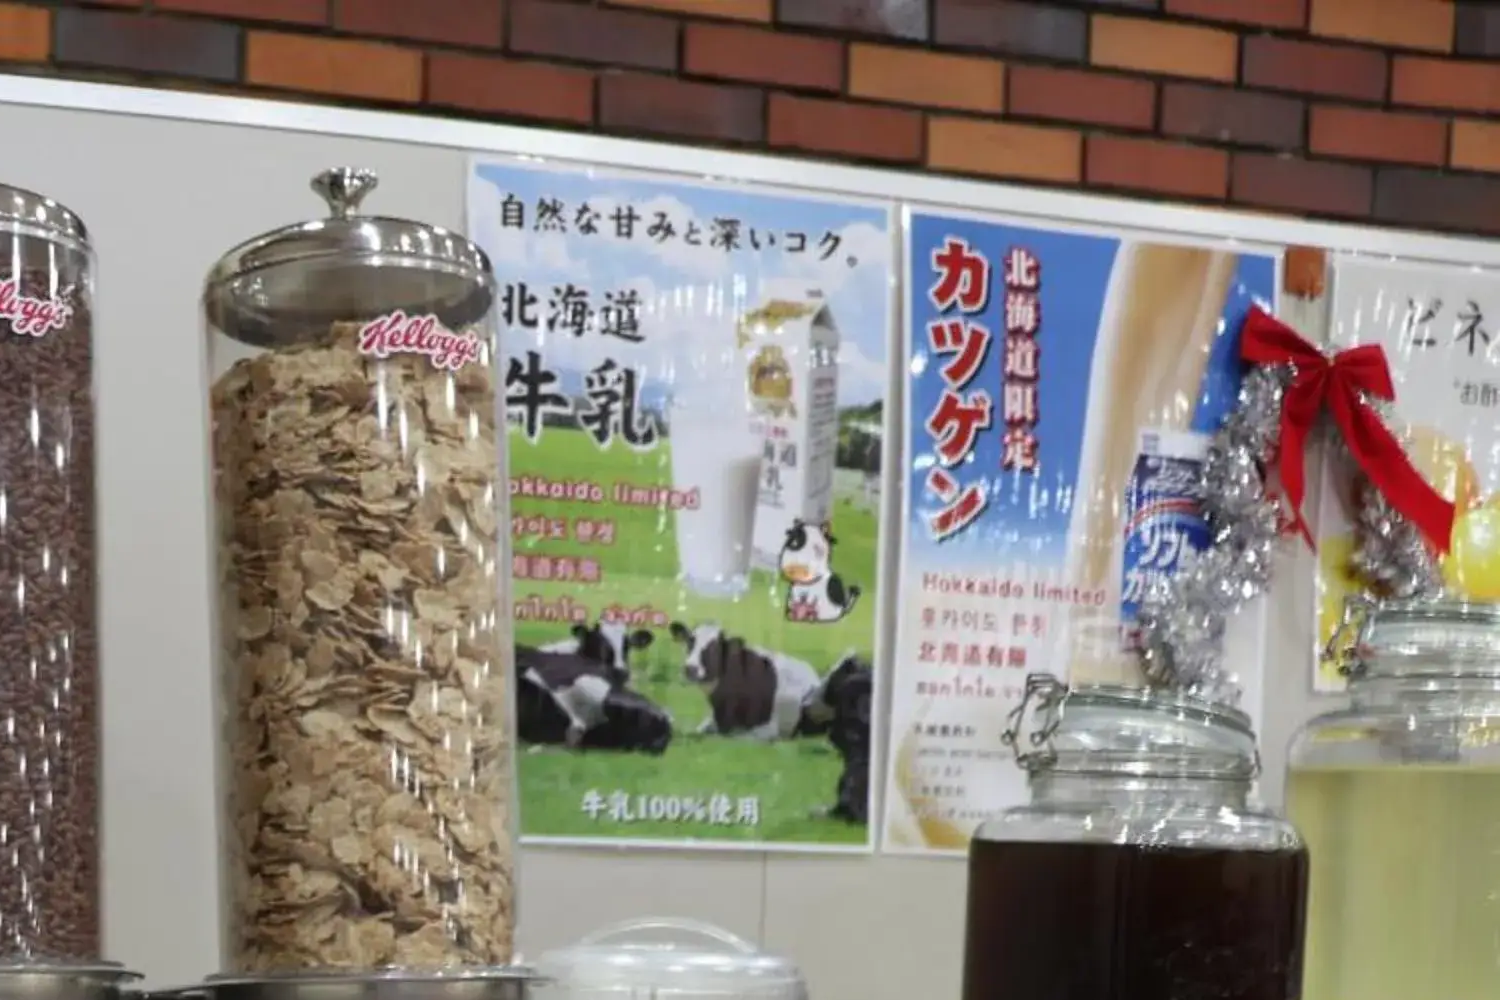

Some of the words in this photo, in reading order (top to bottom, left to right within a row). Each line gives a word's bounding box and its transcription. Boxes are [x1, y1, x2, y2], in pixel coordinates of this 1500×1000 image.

[499, 193, 859, 268] 自然な甘みと深いコク。
[359, 308, 482, 371] Kellogg's
[501, 282, 646, 344] 北海道
[925, 233, 992, 542] カツゲン
[1002, 247, 1042, 474] 北海道限定
[503, 350, 658, 450] 牛乳
[509, 475, 604, 502] okkaido
[922, 572, 1025, 600] Hokkaido
[1033, 580, 1107, 607] limited
[580, 788, 760, 825] 牛乳100%使用
